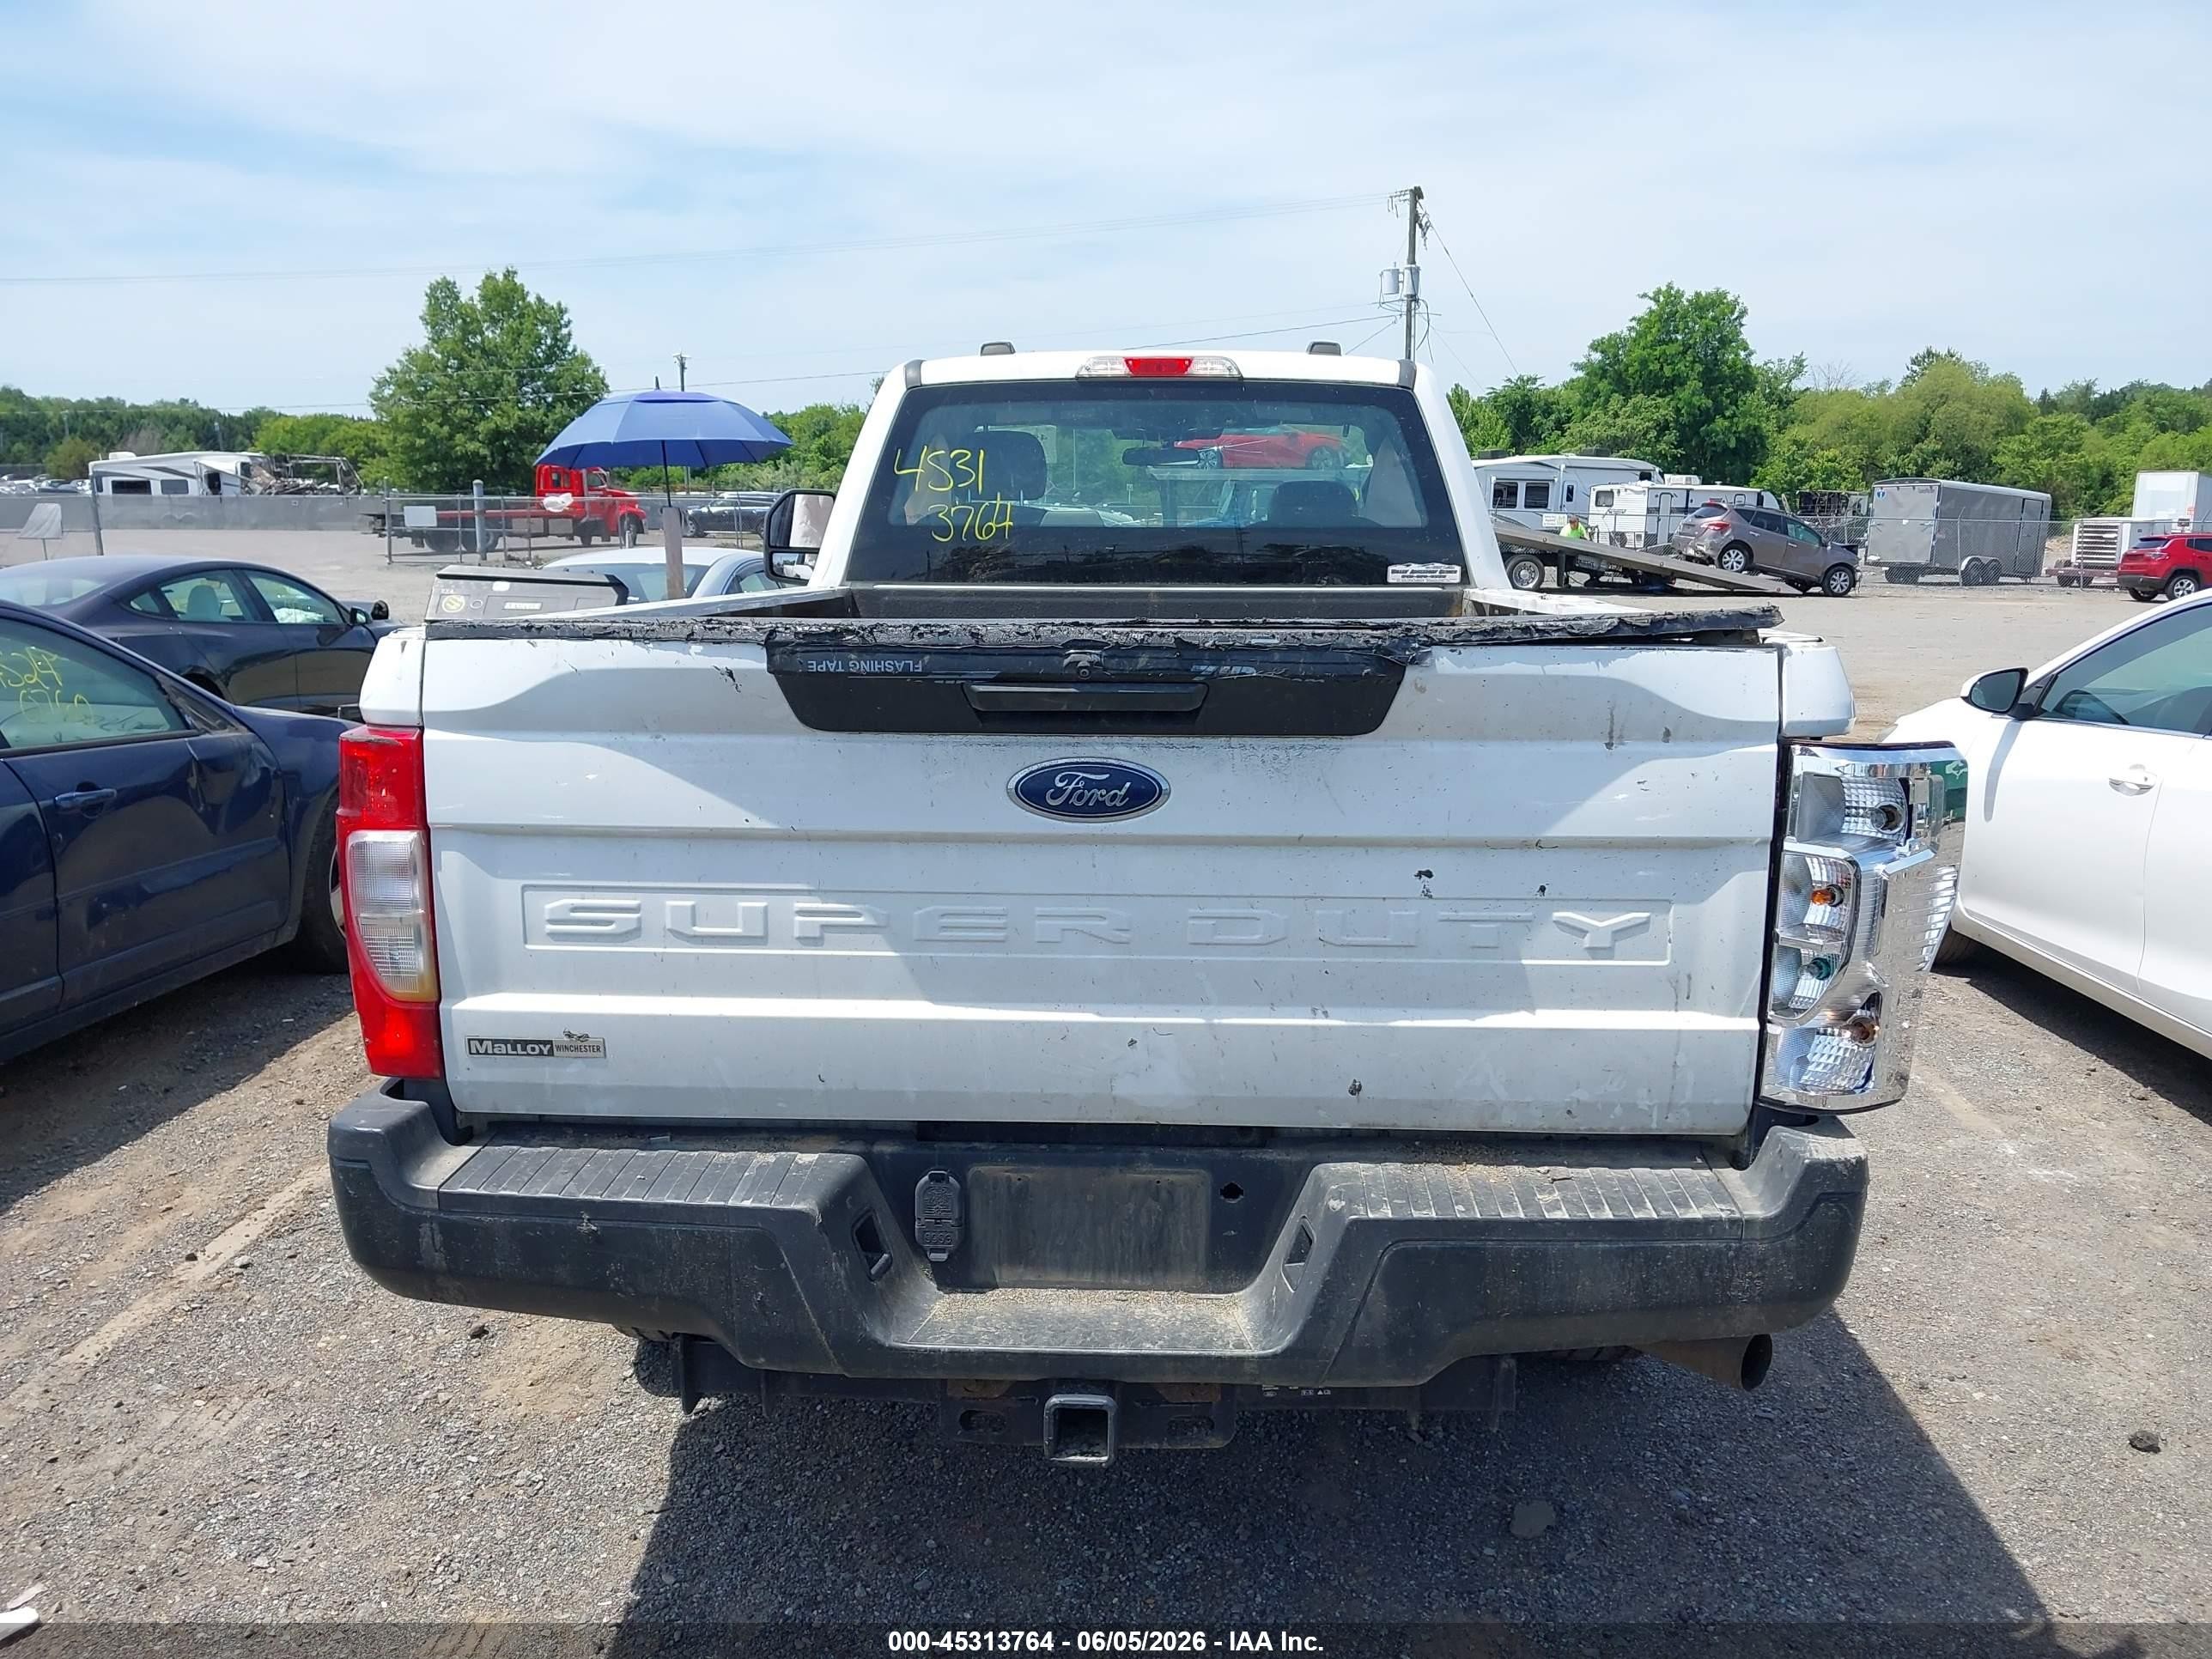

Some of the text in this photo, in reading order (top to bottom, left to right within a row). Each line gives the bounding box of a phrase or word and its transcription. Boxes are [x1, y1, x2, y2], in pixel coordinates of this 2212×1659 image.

[894, 446, 985, 495] 4531
[928, 492, 1014, 542] 3764
[807, 659, 923, 673] FLASHING TAPE
[1045, 771, 1132, 807] Ford
[544, 898, 1651, 950] SUPER DUTY
[555, 1044, 601, 1054] WINCHESTER
